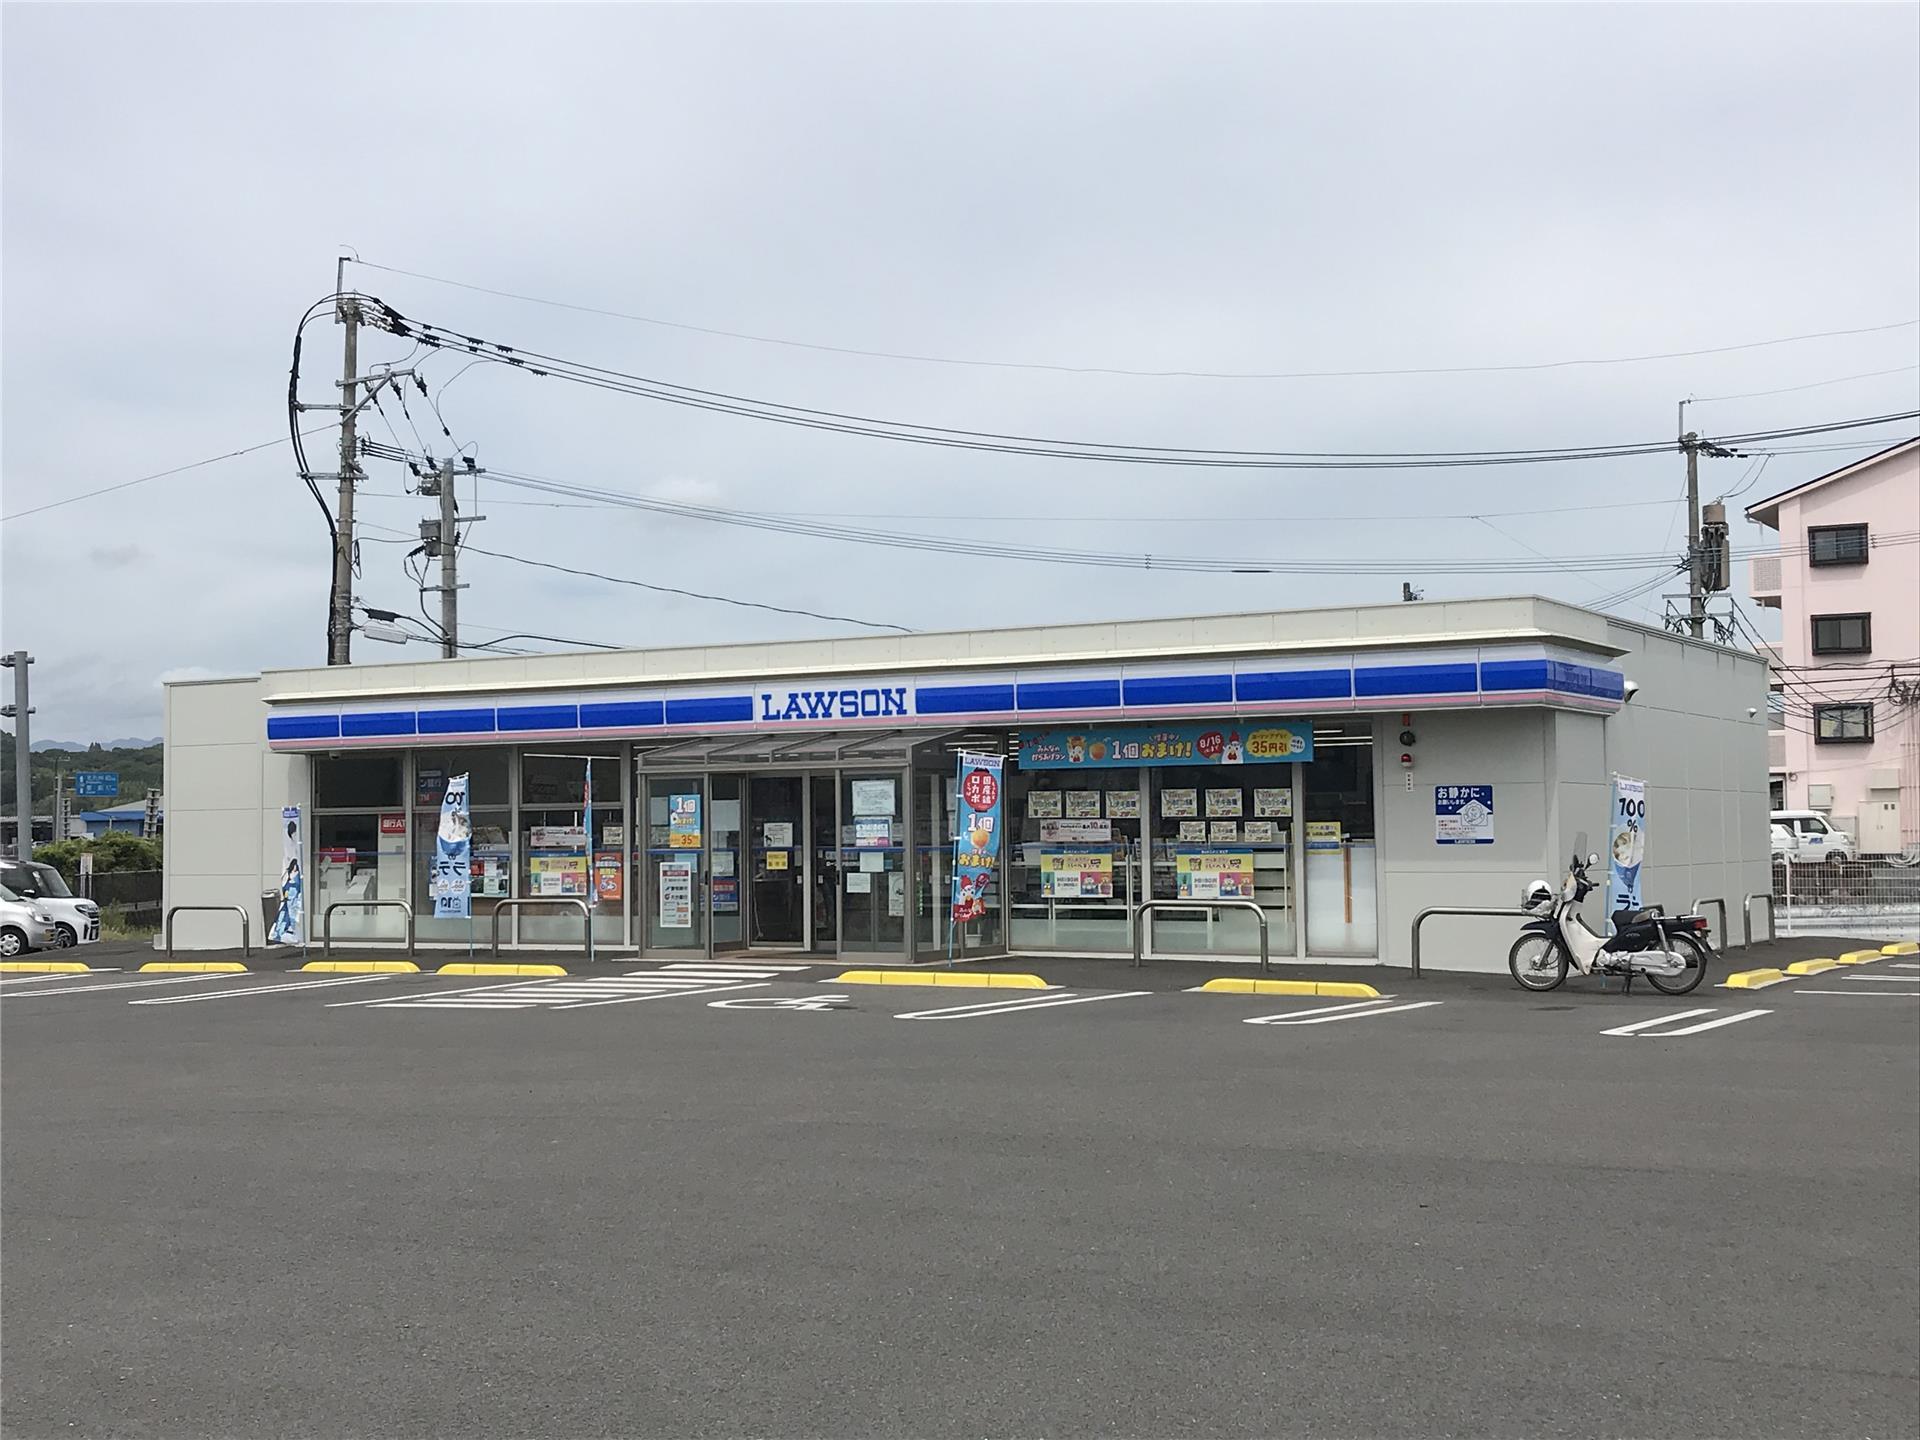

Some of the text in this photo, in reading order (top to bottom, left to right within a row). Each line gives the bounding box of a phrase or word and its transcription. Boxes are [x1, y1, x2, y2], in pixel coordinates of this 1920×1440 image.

[761, 688, 907, 721] LAWSON
[1199, 735, 1222, 749] 8/16
[1251, 740, 1288, 754] 35円引
[1112, 740, 1139, 759] 1個
[964, 757, 1001, 768] LAWSON
[971, 776, 981, 804] ロカボ
[1437, 787, 1480, 799] お静かに
[681, 834, 693, 846] 35
